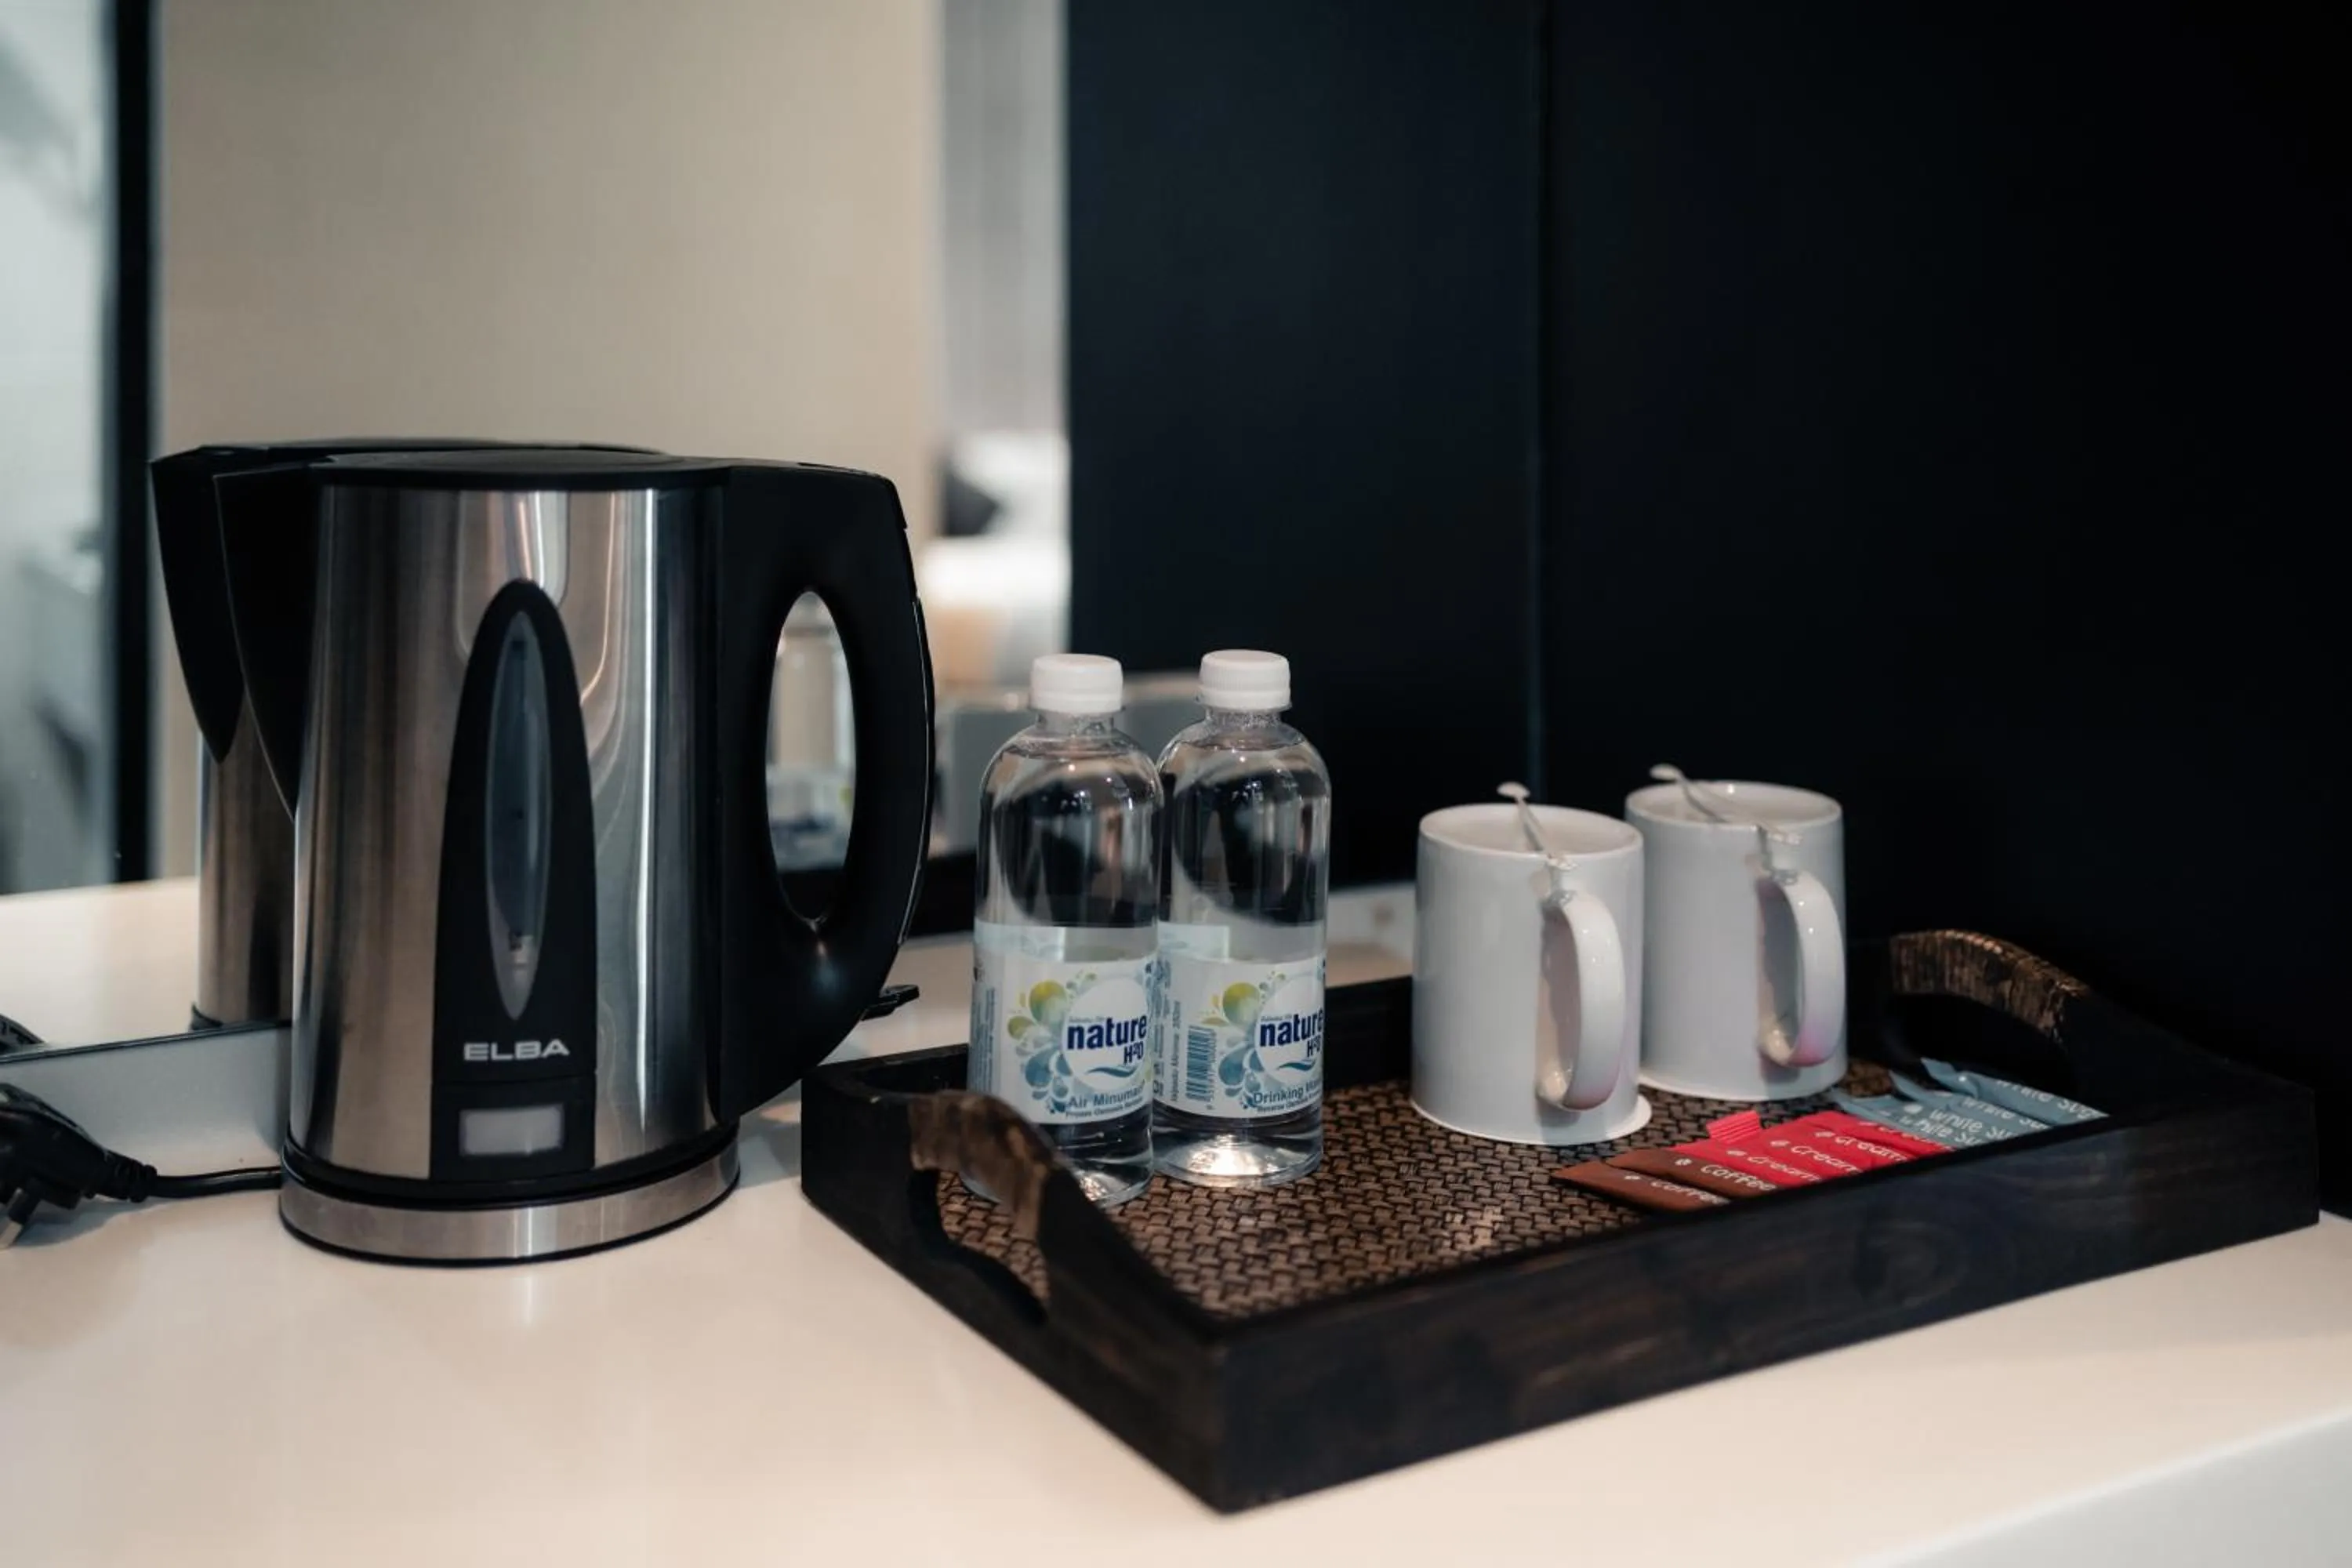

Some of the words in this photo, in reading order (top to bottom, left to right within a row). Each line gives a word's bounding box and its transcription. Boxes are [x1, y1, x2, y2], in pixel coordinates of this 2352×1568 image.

[1067, 1015, 1147, 1050] nature
[463, 1039, 570, 1061] ELBA
[1069, 1095, 1088, 1108] Air
[1254, 1087, 1304, 1104] Drinking
[1835, 1136, 1908, 1162] Cream
[1700, 1164, 1777, 1191] Coffee
